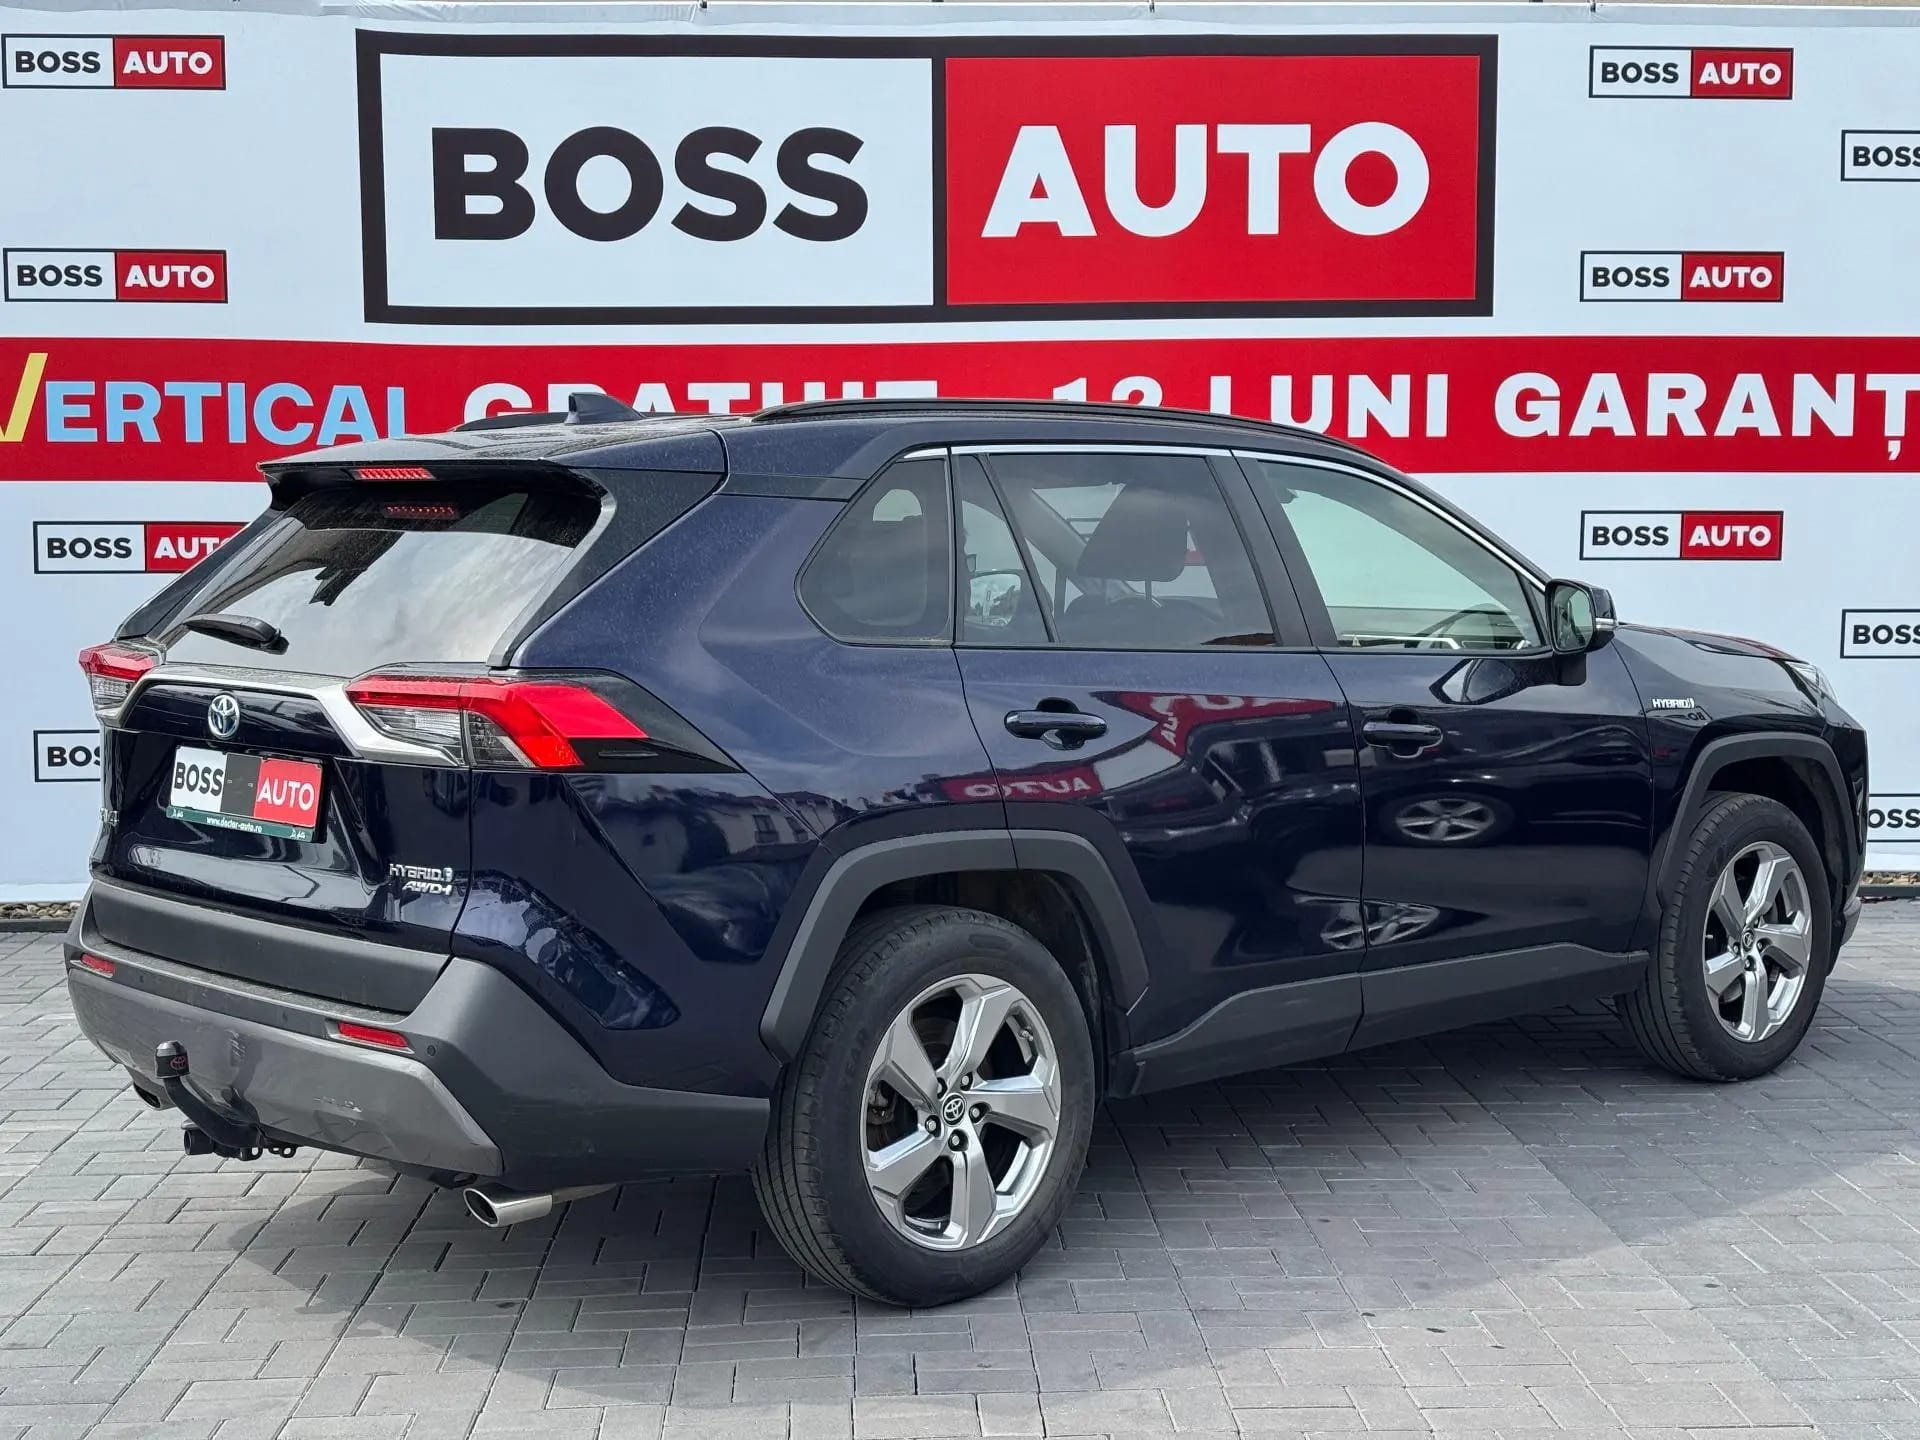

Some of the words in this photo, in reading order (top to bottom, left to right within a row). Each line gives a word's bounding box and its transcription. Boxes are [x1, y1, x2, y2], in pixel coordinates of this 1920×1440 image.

[15, 50, 101, 74] BOSS
[123, 51, 213, 75] AUTO
[1601, 62, 1680, 84] BOSS
[1699, 62, 1782, 86] AUTO
[432, 126, 869, 242] BOSS
[981, 122, 1430, 238] AUTO
[17, 264, 103, 288] BOSS
[125, 264, 215, 289] AUTO
[1592, 266, 1670, 288] BOSS
[1689, 266, 1773, 289] AUTO
[1592, 526, 1669, 547] BOSS
[1688, 525, 1772, 548] AUTO
[47, 537, 132, 560] BOSS
[154, 537, 232, 560] AUT
[1652, 698, 1689, 708] HYBRID
[174, 762, 224, 797] BOSS
[257, 777, 315, 811] AUTO
[389, 863, 443, 881] HYBRID
